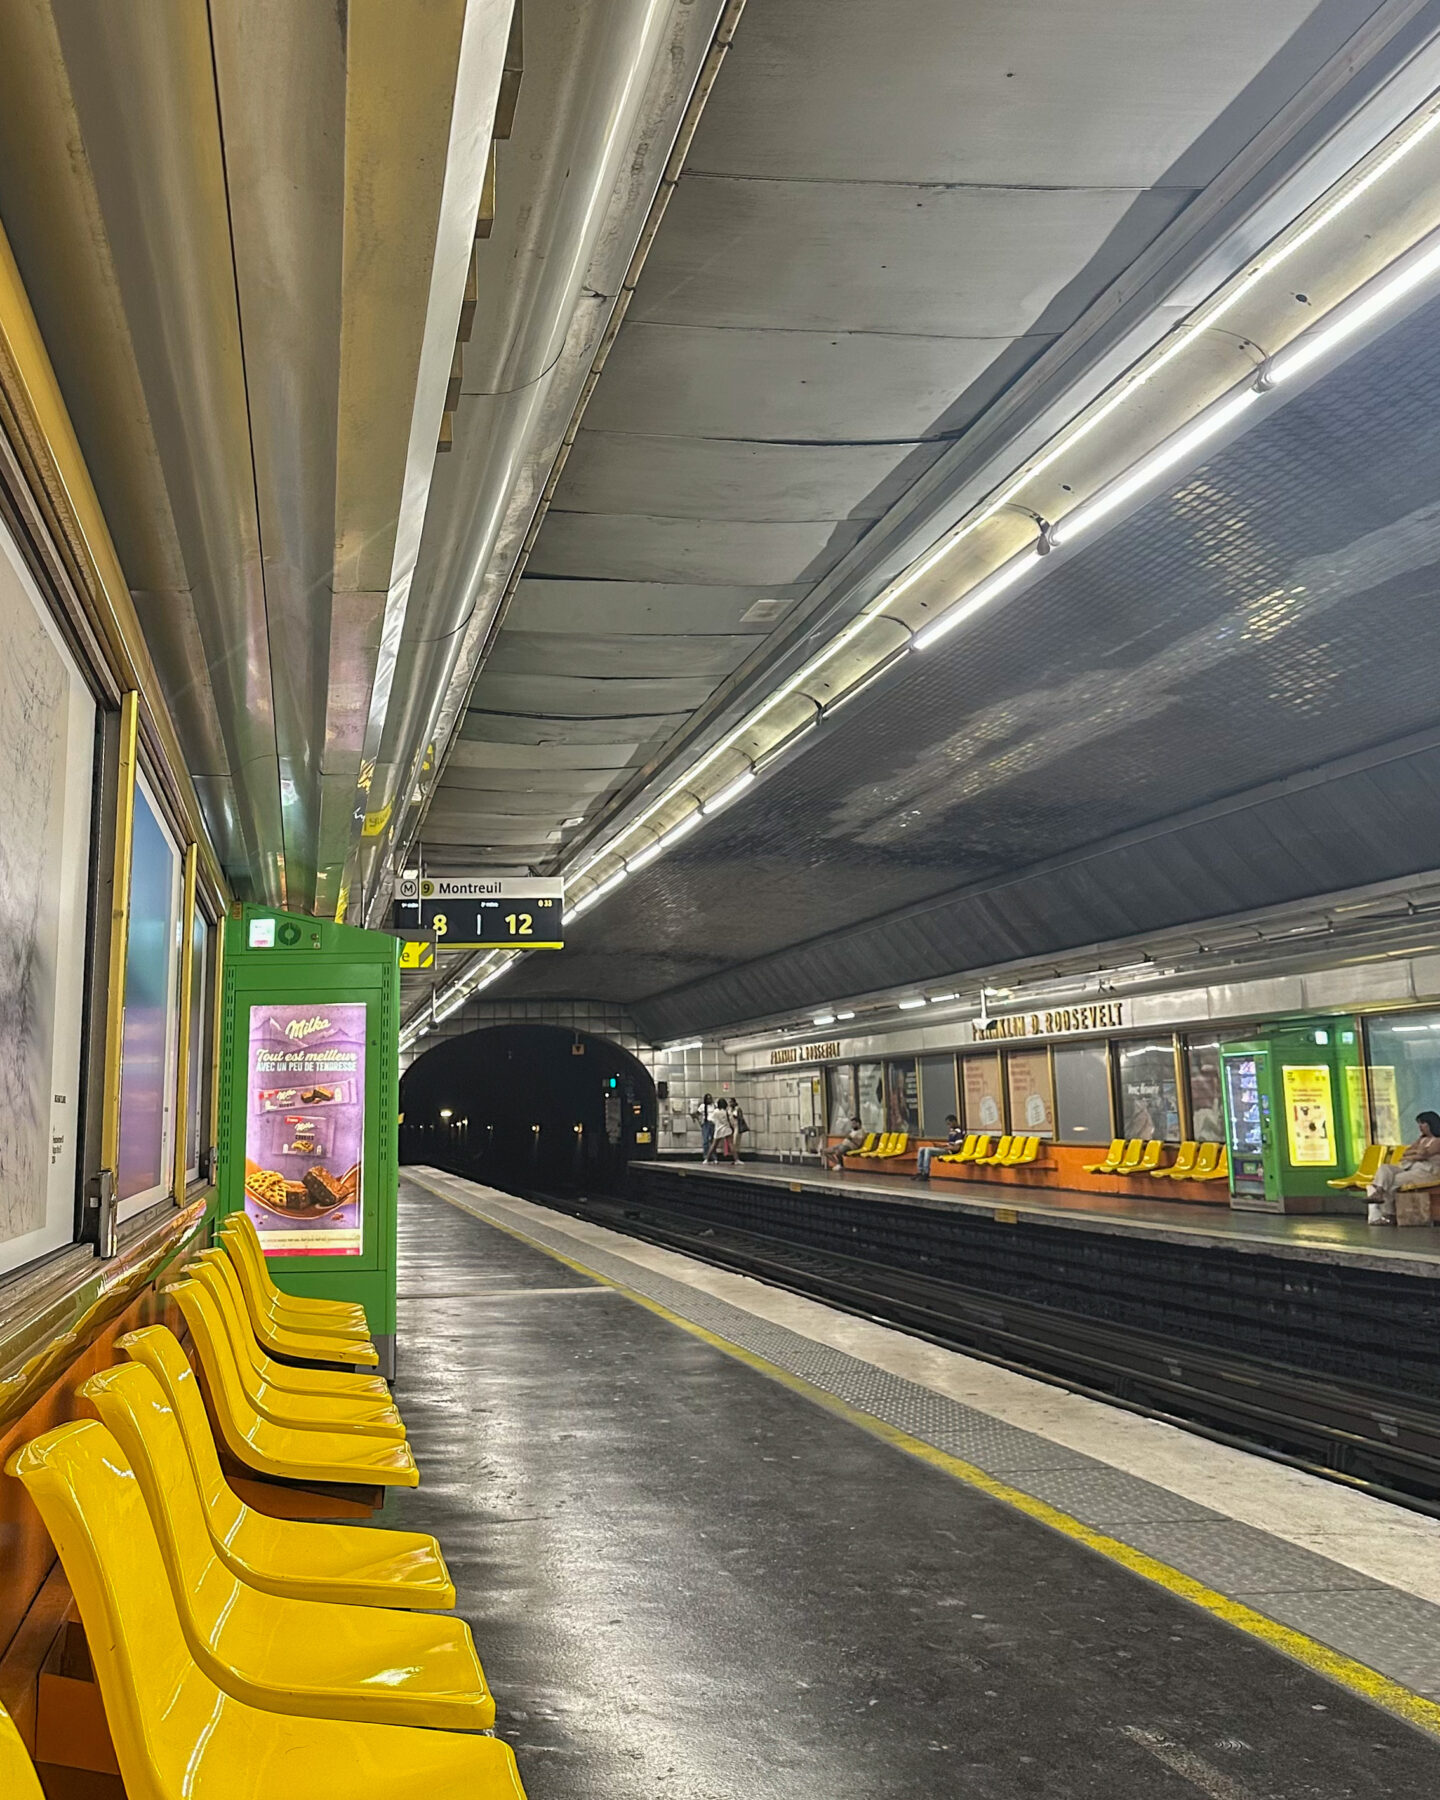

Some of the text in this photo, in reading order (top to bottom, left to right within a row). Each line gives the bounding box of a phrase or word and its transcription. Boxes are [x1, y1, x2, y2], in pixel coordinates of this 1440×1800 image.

[439, 882, 502, 894] Montreuil
[432, 914, 448, 936] 8
[504, 914, 533, 935] 12
[284, 1016, 331, 1039] Milka
[1045, 1002, 1123, 1033] ROOSEVELT
[256, 1048, 357, 1062] Tout est meilleur
[256, 1062, 275, 1072] AVEC
[277, 1062, 287, 1072] UN
[288, 1062, 302, 1071] PEU
[304, 1062, 314, 1071] DE
